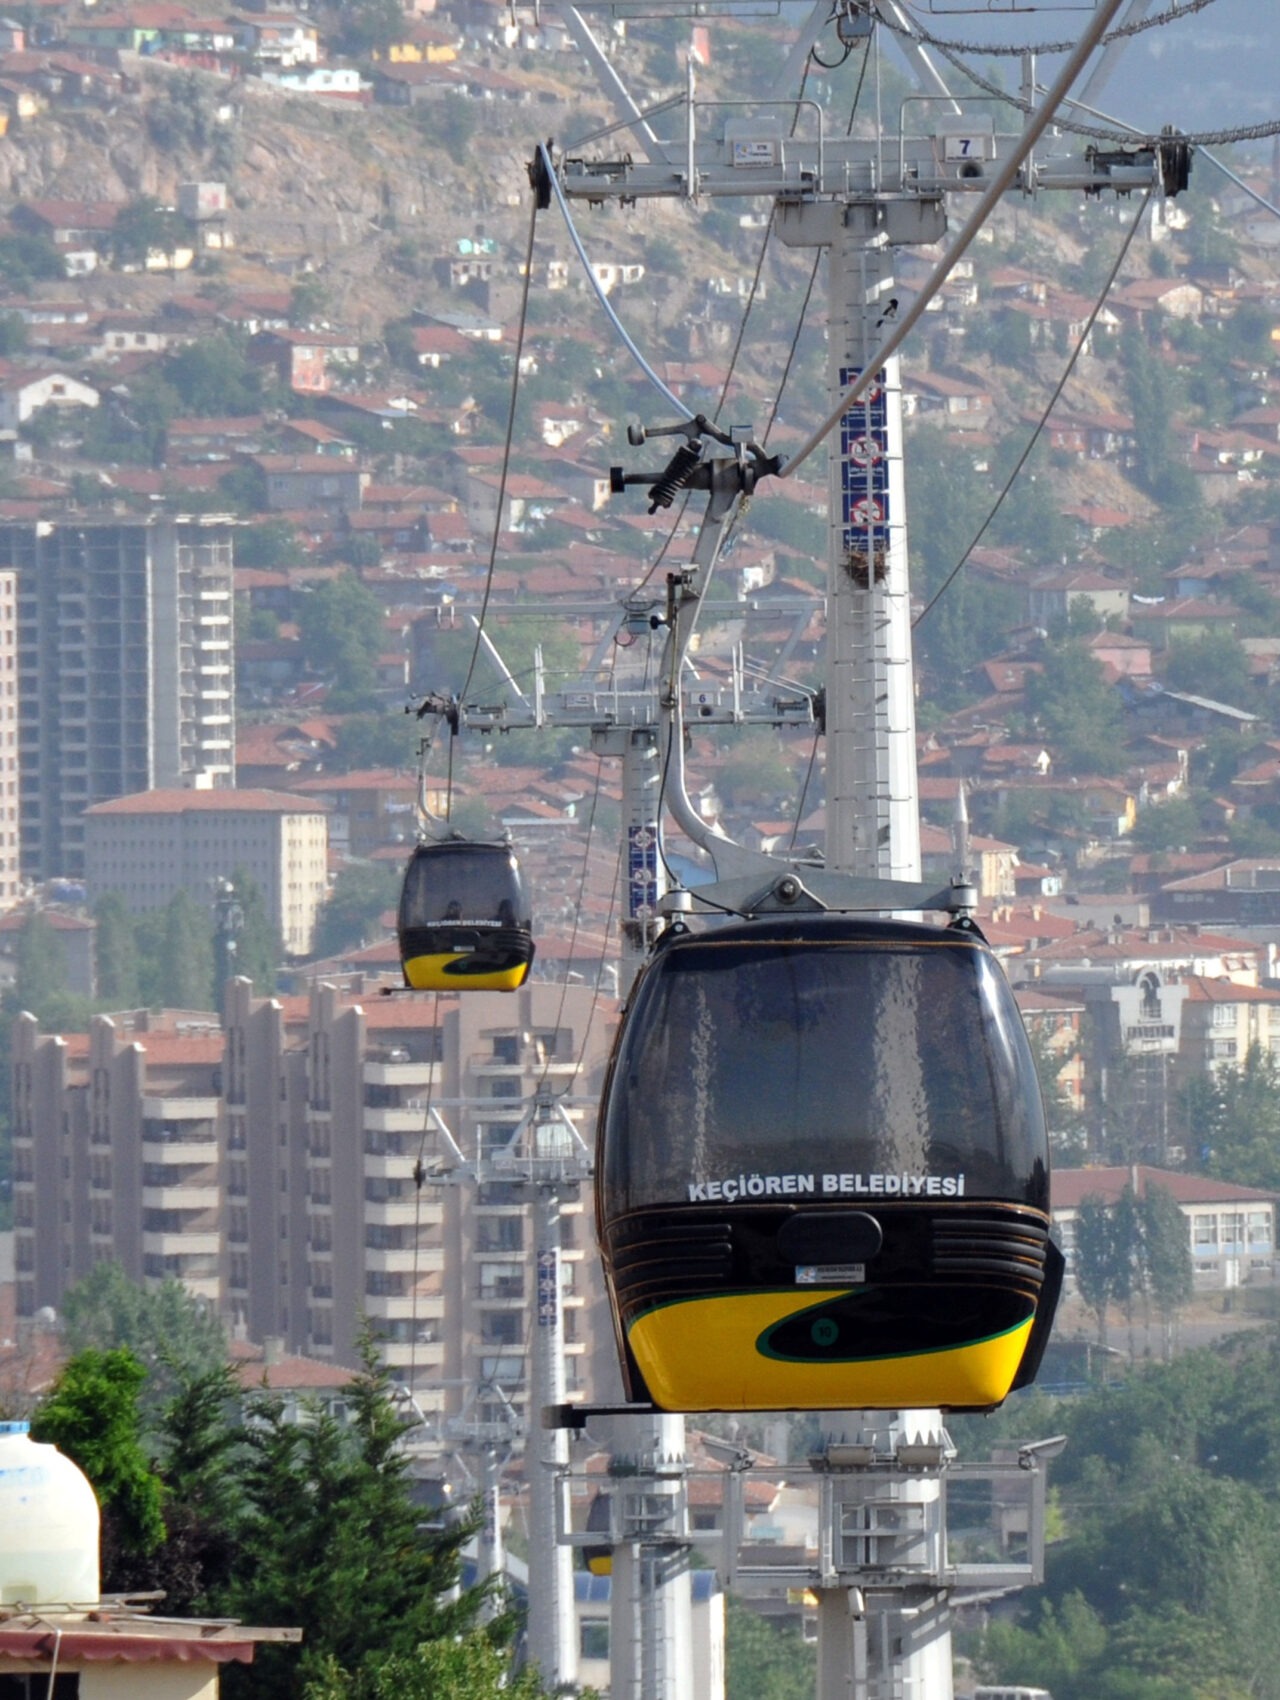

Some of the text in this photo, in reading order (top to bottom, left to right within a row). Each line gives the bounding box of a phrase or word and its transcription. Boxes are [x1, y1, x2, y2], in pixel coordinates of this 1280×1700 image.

[959, 139, 971, 155] 7
[699, 694, 706, 703] 6
[689, 1172, 966, 1202] KEÇİÖREN BELEDİYESİ
